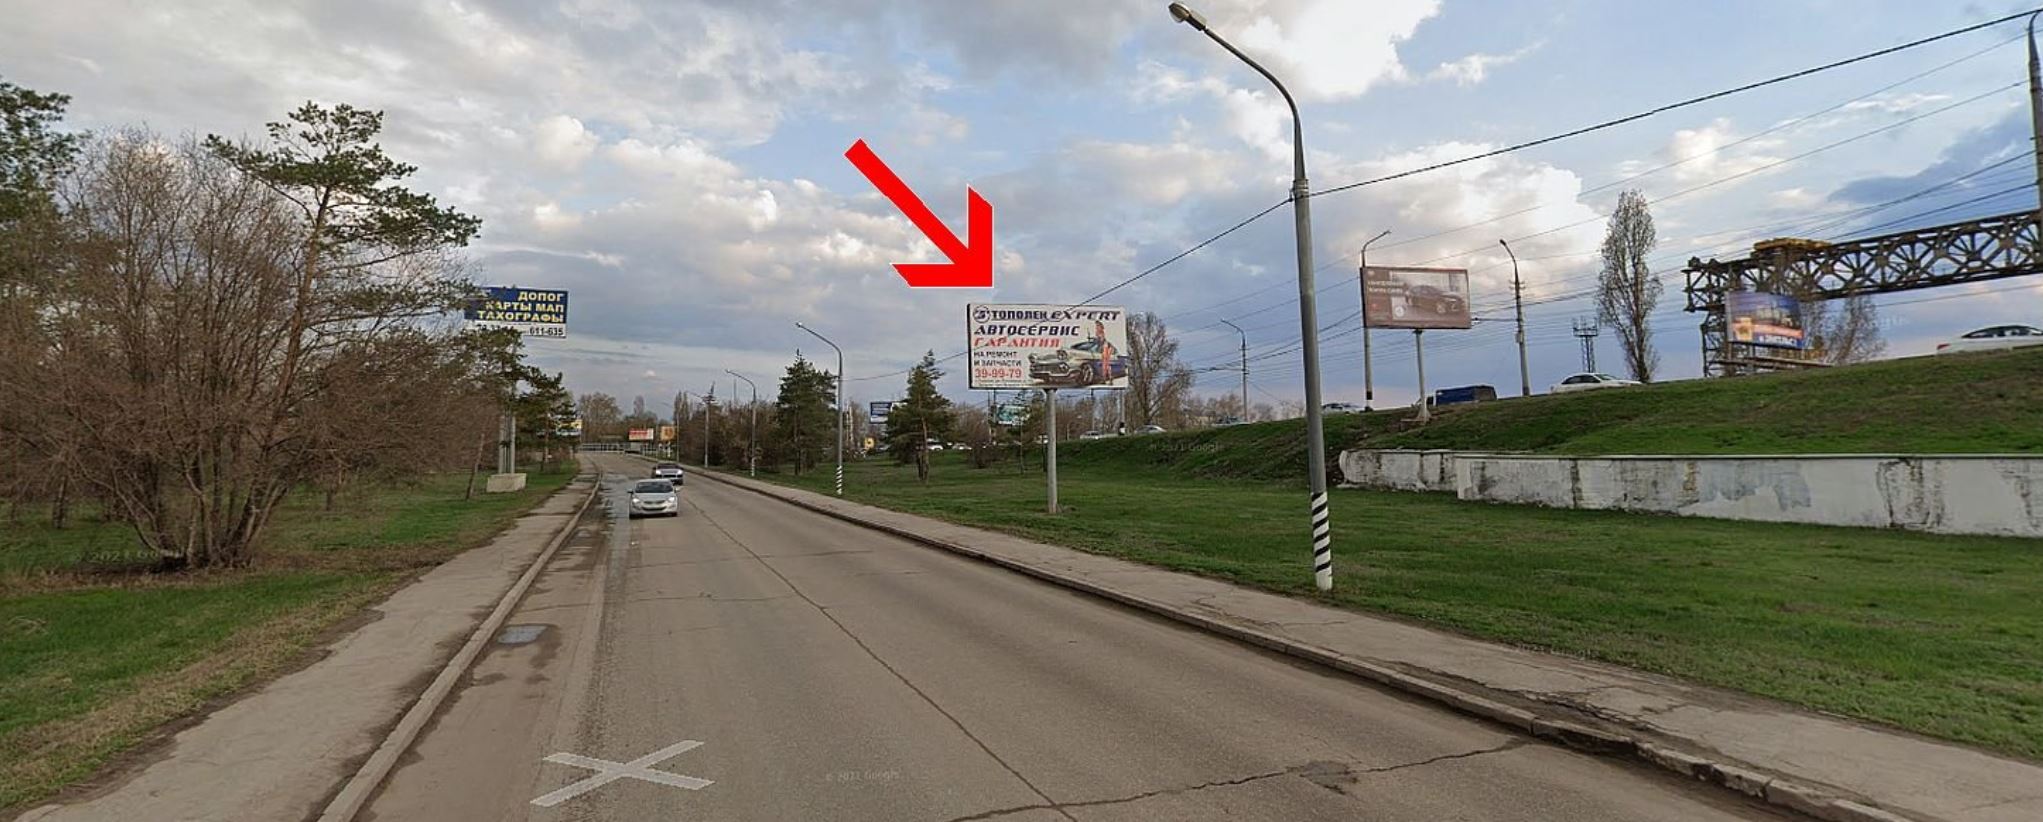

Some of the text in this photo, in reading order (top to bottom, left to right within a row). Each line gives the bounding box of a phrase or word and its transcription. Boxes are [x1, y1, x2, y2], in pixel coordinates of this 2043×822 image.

[518, 291, 565, 301] ДОПОГ
[485, 301, 564, 313] КАРТЫ МАП
[477, 310, 564, 322] ТАХОГРАФЫ
[529, 326, 564, 336] 611-635
[974, 324, 1080, 337] АВТОСЕРВИС
[973, 336, 1061, 349] ГАРАНТИЯ
[987, 351, 1018, 359] РЕМОНТ
[974, 368, 1022, 379] 39-99-79
